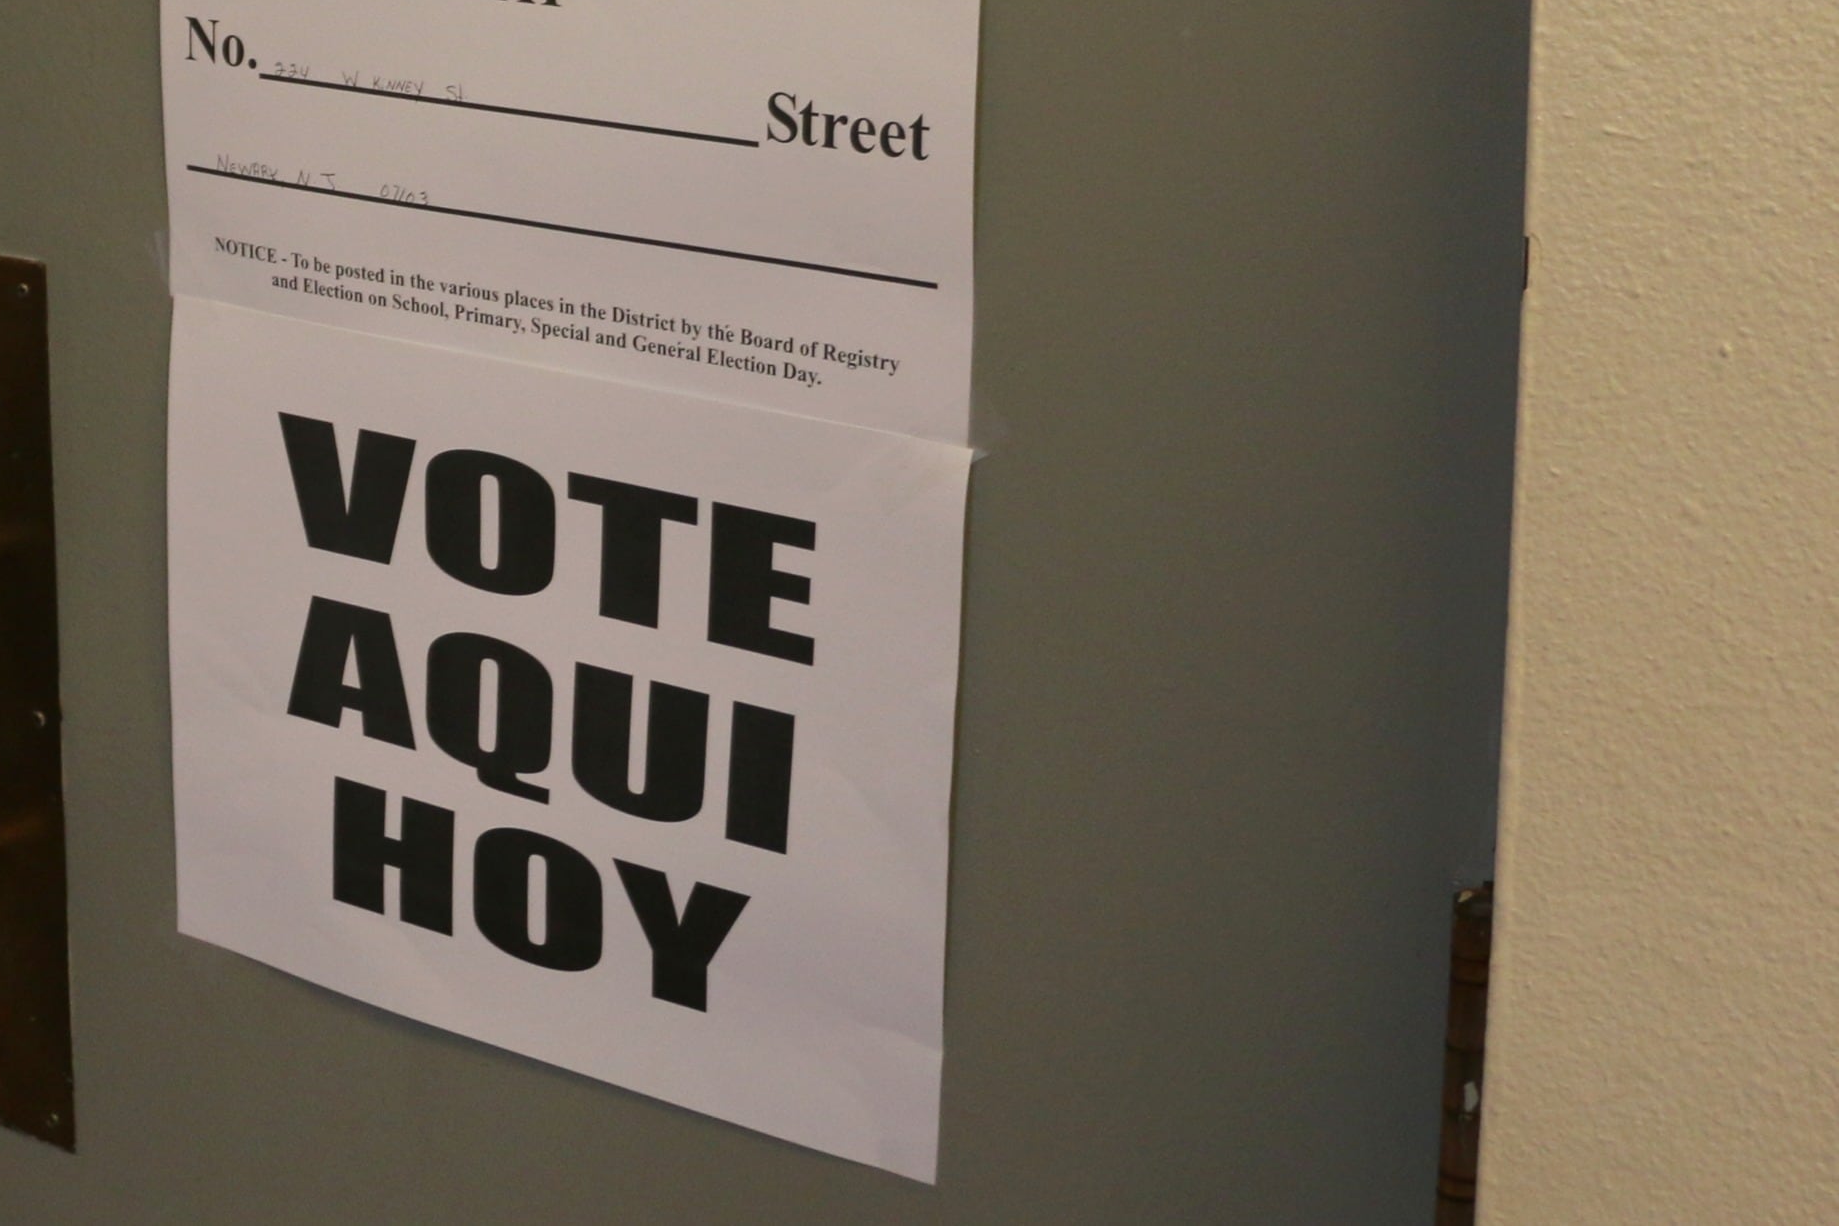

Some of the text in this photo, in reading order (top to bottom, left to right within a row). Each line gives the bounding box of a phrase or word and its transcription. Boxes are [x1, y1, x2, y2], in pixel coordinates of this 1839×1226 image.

[184, 16, 258, 70] No.
[341, 69, 359, 87] W
[766, 91, 931, 161] Street
[214, 236, 278, 264] NOTICE
[291, 252, 309, 271] To
[313, 256, 331, 275] be
[335, 263, 385, 284] posted
[390, 270, 405, 287] in
[410, 273, 435, 292] the
[439, 281, 499, 303] various
[504, 289, 554, 312] places
[559, 297, 575, 315] in
[580, 301, 607, 320] the
[612, 306, 676, 332] District
[681, 318, 702, 341] by
[707, 323, 735, 343] the
[740, 327, 794, 355] Board
[799, 340, 819, 359] of
[822, 343, 901, 377] Registry
[271, 275, 823, 389] and Election on School, Primary, Special and General Election Day.
[277, 410, 818, 668] VOTE
[285, 594, 796, 856] AQUI
[331, 775, 753, 1014] HOY
